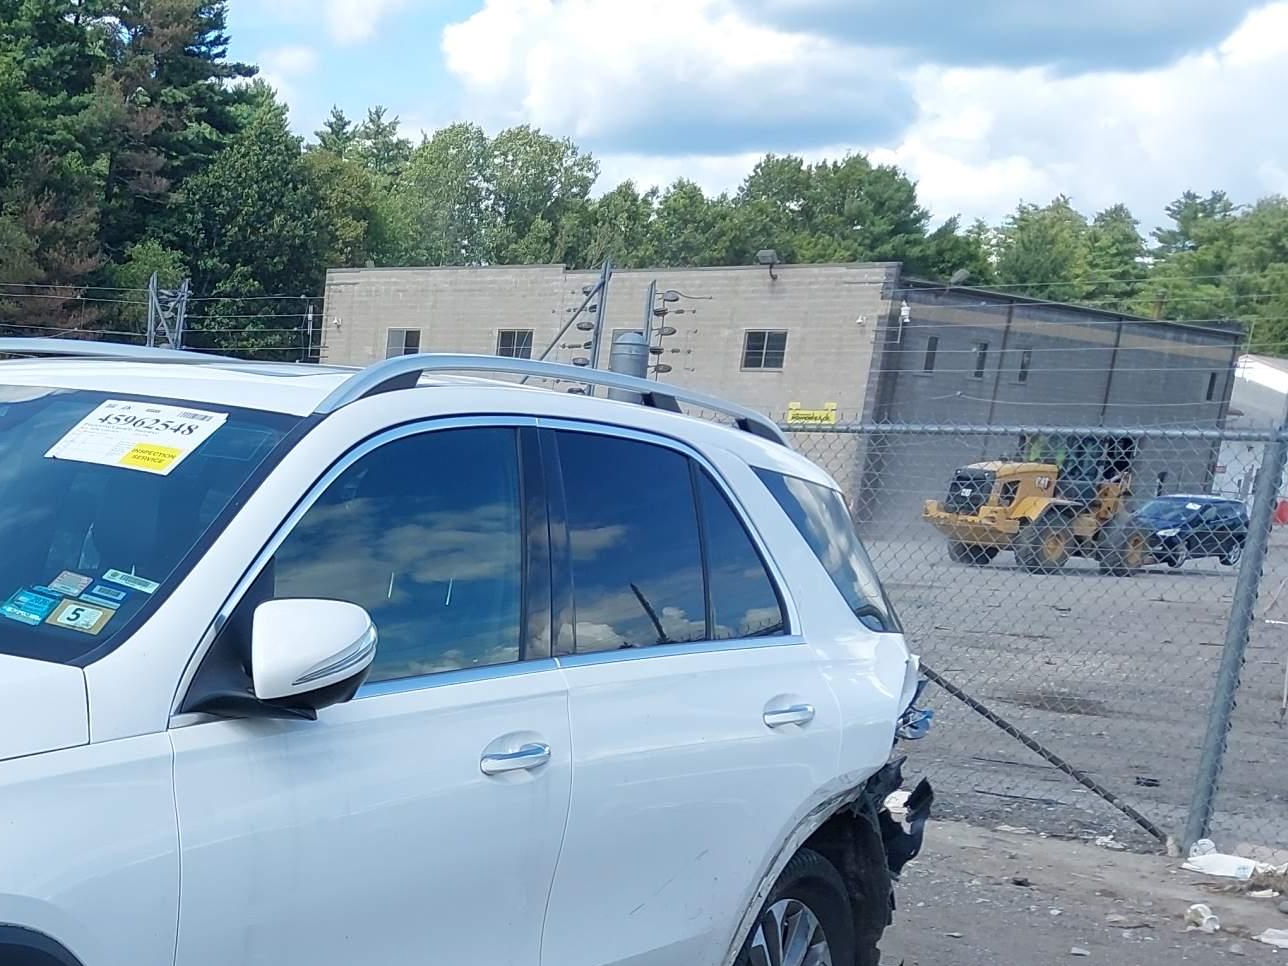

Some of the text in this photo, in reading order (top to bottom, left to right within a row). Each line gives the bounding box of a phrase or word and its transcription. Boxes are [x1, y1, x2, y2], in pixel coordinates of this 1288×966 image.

[98, 413, 199, 436] 45962548
[131, 448, 176, 459] INSPECTION
[132, 454, 165, 464] SERVICE
[66, 608, 85, 622] 5
